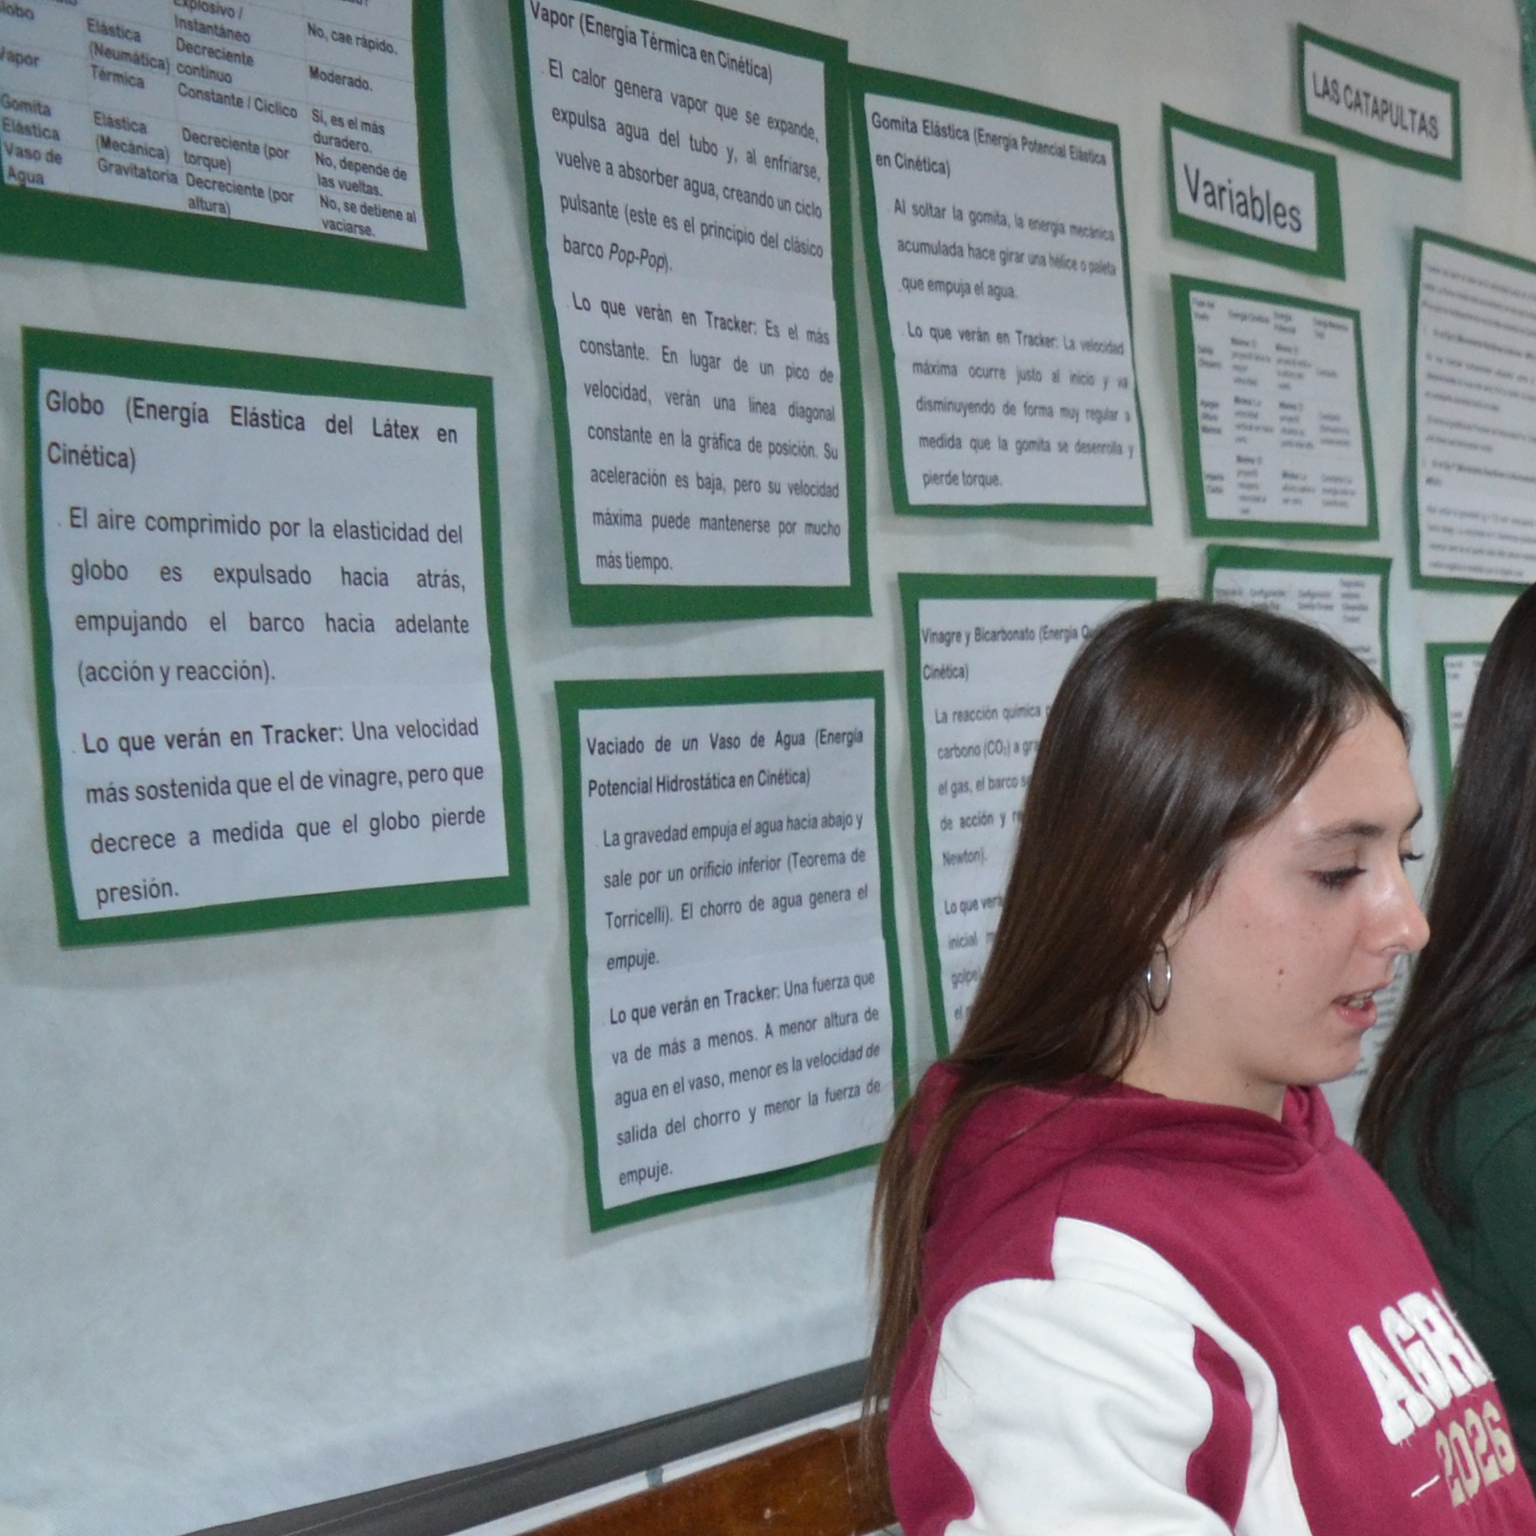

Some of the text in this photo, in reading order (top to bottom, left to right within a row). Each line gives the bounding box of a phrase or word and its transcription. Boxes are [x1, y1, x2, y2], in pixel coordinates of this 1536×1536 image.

[86, 17, 142, 43] Elástica
[530, 0, 772, 85] Vapor (Energía Térmica en Cinética)
[90, 41, 170, 78] (Neumática)
[176, 36, 254, 67] Decreciente
[90, 64, 145, 89] Térmica
[309, 65, 372, 91] Moderado.
[0, 93, 52, 117] Gomita
[178, 82, 244, 108] Constante
[548, 58, 818, 143] El calor genera vapor que se expande,
[1313, 72, 1439, 140] LAS CATAPULTAS
[2, 117, 60, 141] Elástica
[313, 130, 372, 153] duradero.
[871, 111, 1107, 166] Gomita Elástica (Energía Potencial Elástica
[3, 142, 62, 165] Vaso de
[875, 152, 950, 179] en Cinética)
[8, 166, 44, 187] Agua
[97, 154, 178, 185] Gravitatoria
[894, 198, 1011, 228] Al soltar la gomita,
[1184, 164, 1302, 233] Variables
[322, 219, 375, 236] vaciarse.
[563, 234, 672, 273] barco Pop-Pop).
[572, 291, 830, 345] Lo que verán en Tracker: Es el más
[907, 321, 1057, 348] Lo que verán en Tracker:
[46, 389, 457, 443] Globo (Energía Elástica del Látex en
[47, 441, 135, 474] Cinética)
[70, 506, 462, 544] El aire comprimido por la elasticidad del
[71, 558, 465, 592] globo es expulsado hacia atrás,
[75, 610, 469, 637] empujando el barco hacia adelante
[922, 629, 962, 647] Vinagre
[965, 632, 971, 647] y
[974, 626, 1035, 642] Bicarbonato
[1039, 624, 1078, 644] (Energía
[78, 660, 275, 687] (acción y reacción).
[923, 664, 969, 681] Cinética)
[82, 717, 479, 757] Lo que verán en Tracker: Una velocidad
[586, 728, 863, 755] Vaciado de un Vaso de Agua (Energía
[86, 766, 484, 804] más sostenida que el de vinagre, pero que
[588, 768, 810, 797] Potencial Hidrostática en Cinética)
[91, 806, 485, 854] decrece a medida que el globo pierde
[603, 812, 863, 850] La gravedad empuja el agua hacia abajo y
[96, 878, 179, 909] presión.
[605, 907, 673, 929] Torricelli).
[607, 949, 659, 972] empuje.
[610, 972, 875, 1025] Lo que verán en Tracker: Una fuerza que
[1349, 1287, 1495, 1445] AGR
[1435, 1401, 1516, 1508] 2026
